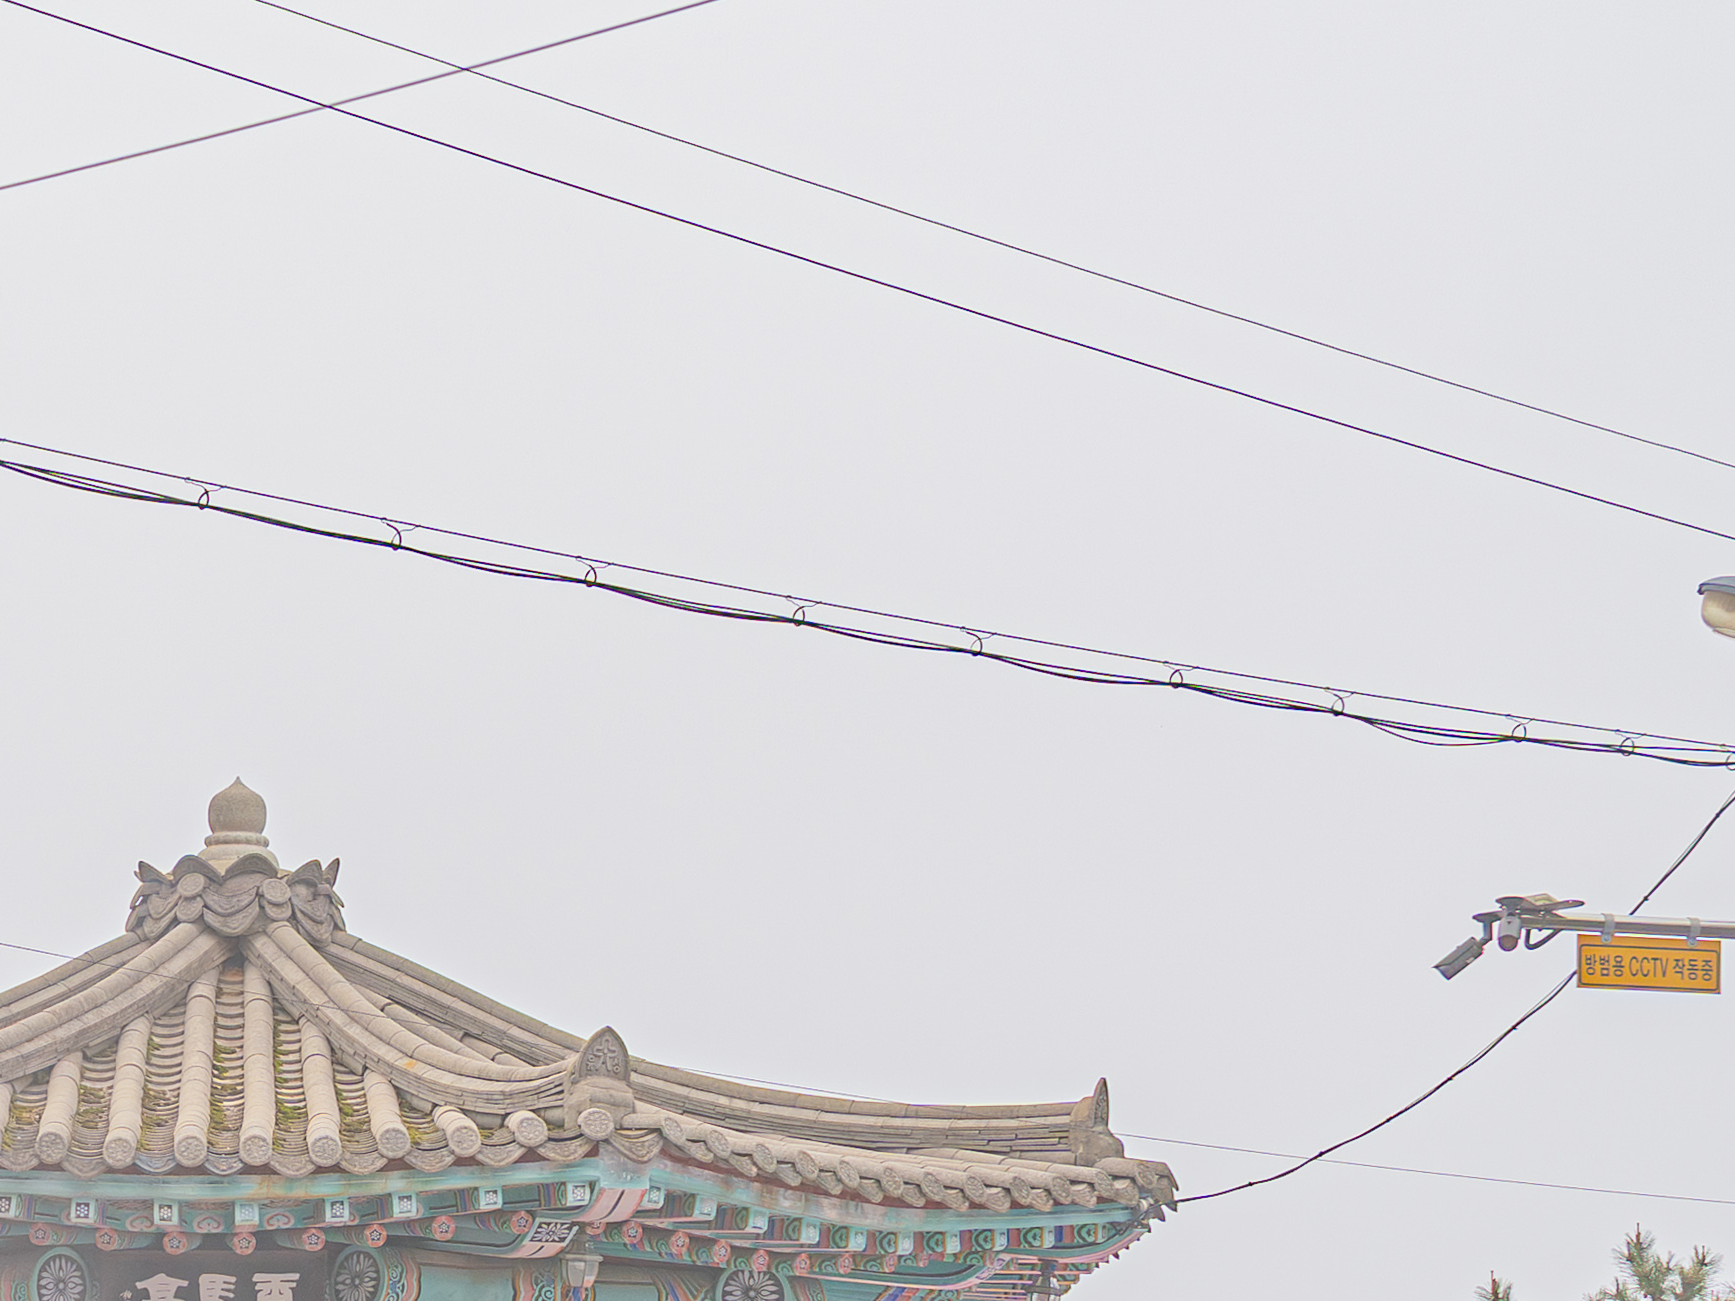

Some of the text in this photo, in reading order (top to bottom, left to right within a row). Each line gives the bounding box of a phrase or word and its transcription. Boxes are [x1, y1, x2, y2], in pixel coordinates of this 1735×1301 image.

[1584, 953, 1714, 982] 방범용 CCTV 작동중
